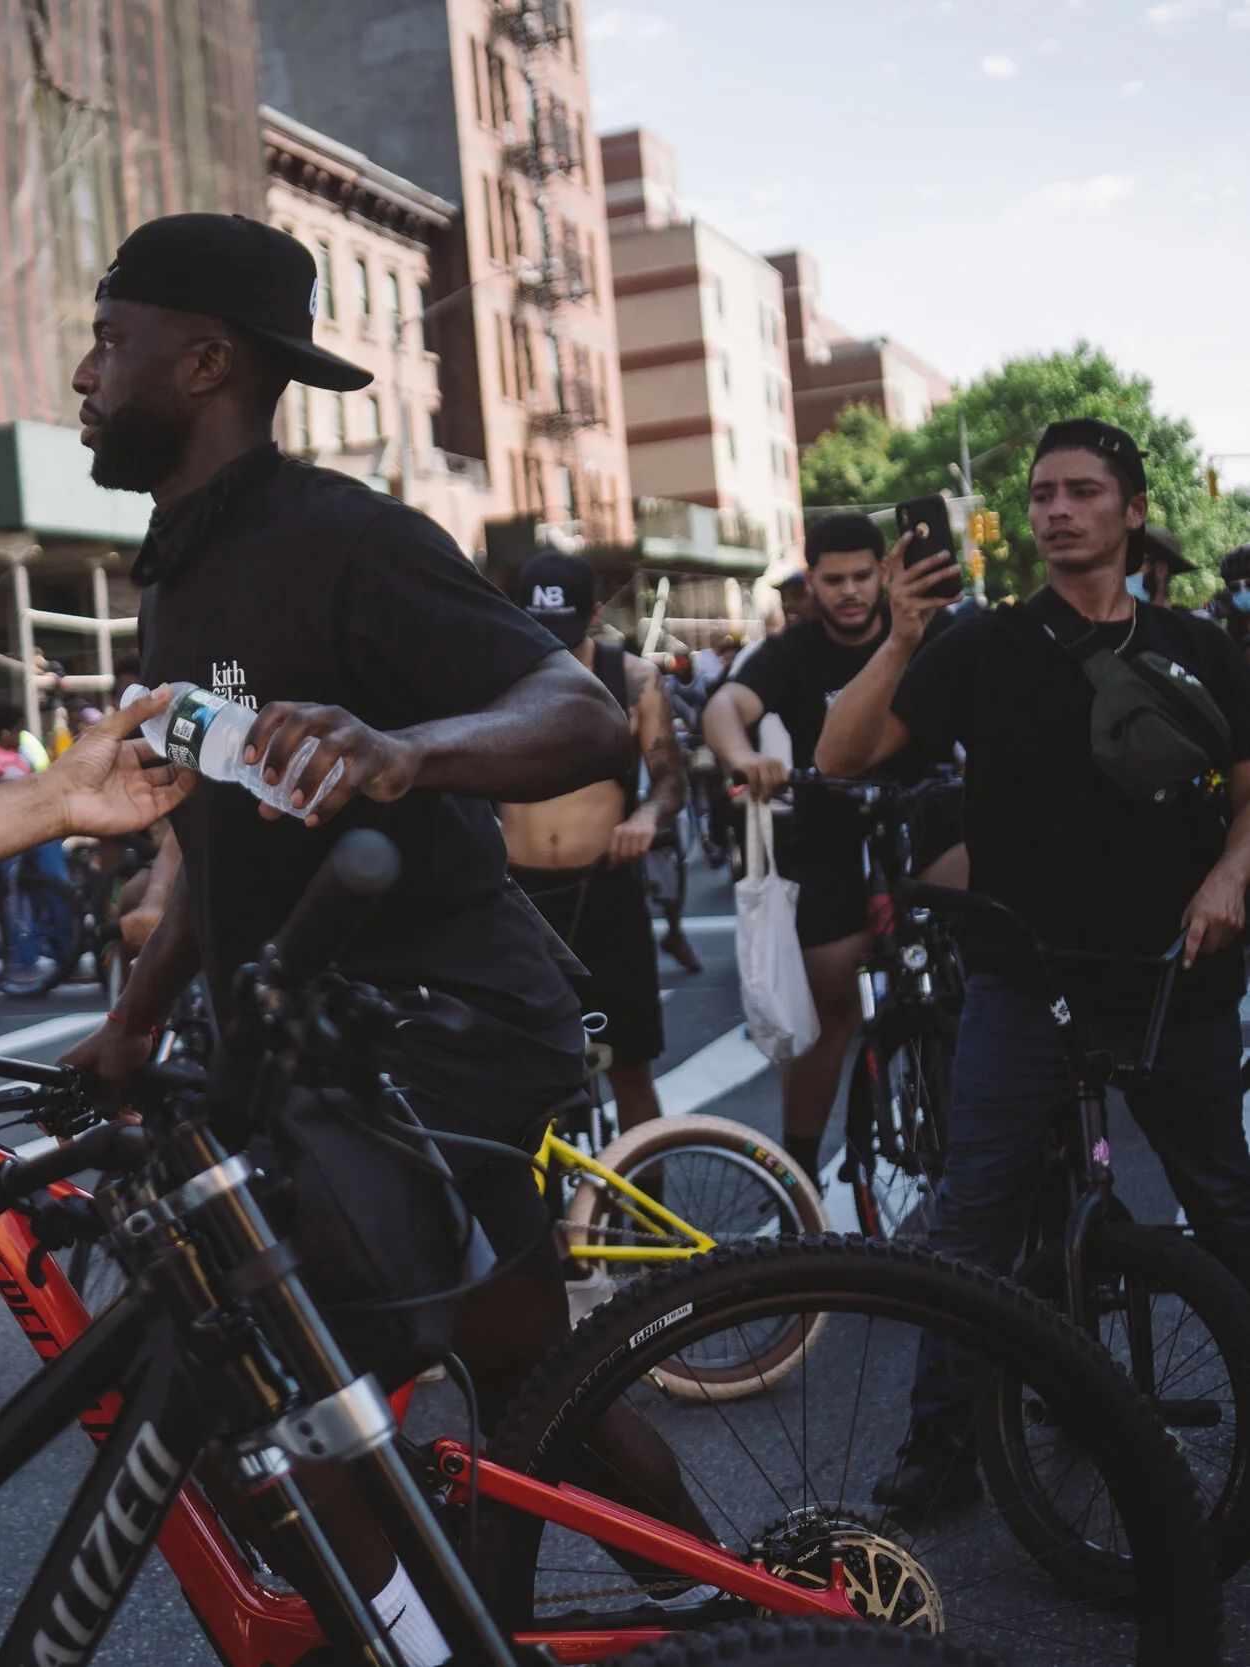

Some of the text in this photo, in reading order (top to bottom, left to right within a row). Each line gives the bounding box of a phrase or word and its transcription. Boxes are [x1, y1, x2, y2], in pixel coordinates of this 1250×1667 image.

[532, 584, 565, 607] NB
[211, 659, 247, 687] kith
[633, 1304, 691, 1345] GRID TRAIL
